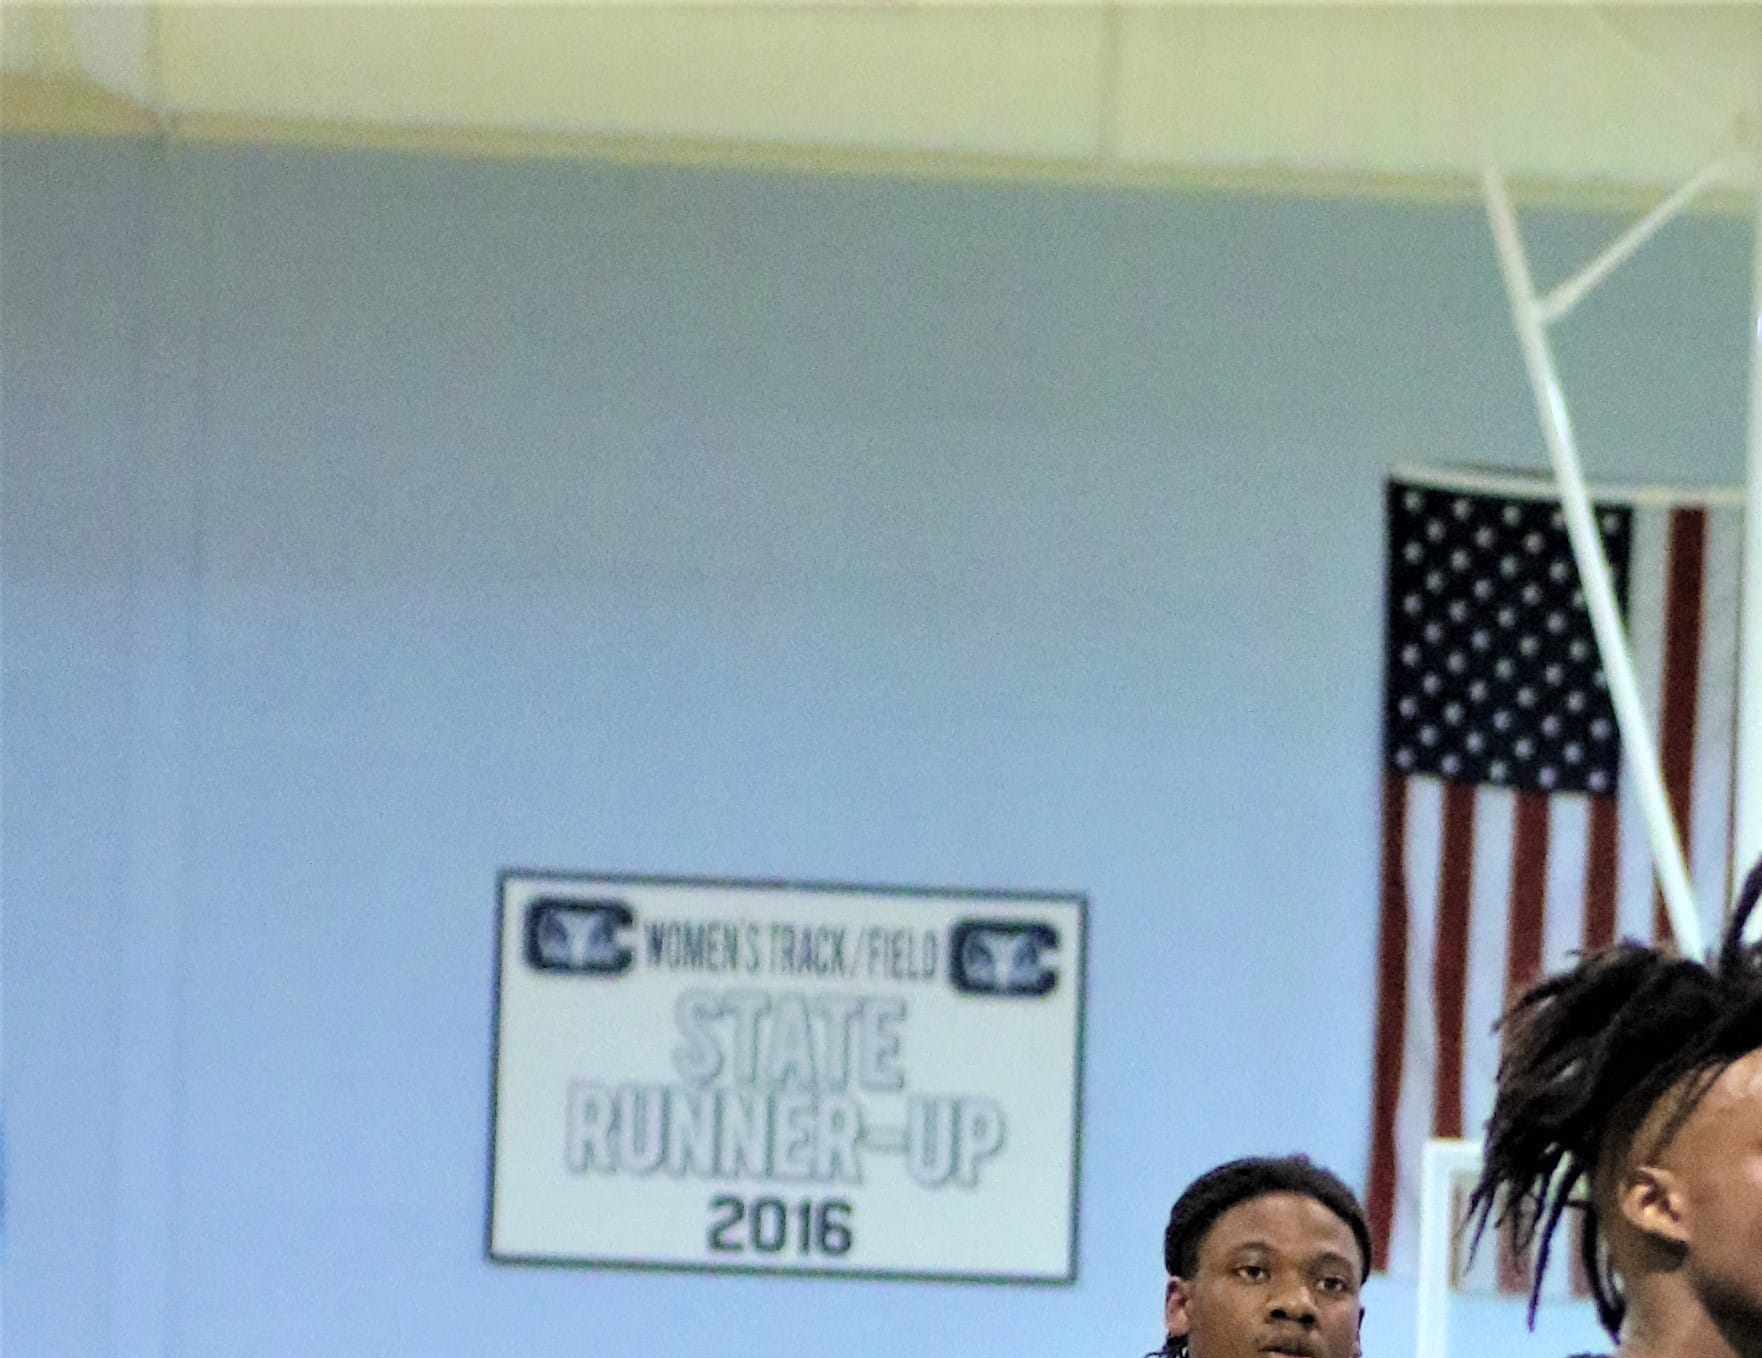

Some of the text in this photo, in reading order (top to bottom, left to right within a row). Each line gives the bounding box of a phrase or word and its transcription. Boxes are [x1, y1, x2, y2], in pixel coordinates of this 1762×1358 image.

[643, 917, 940, 983] WOMEN'S TRACK/FIELD
[673, 988, 909, 1093] STATE
[563, 1079, 1008, 1188] RUNNER-UP
[707, 1193, 854, 1257] 2016
